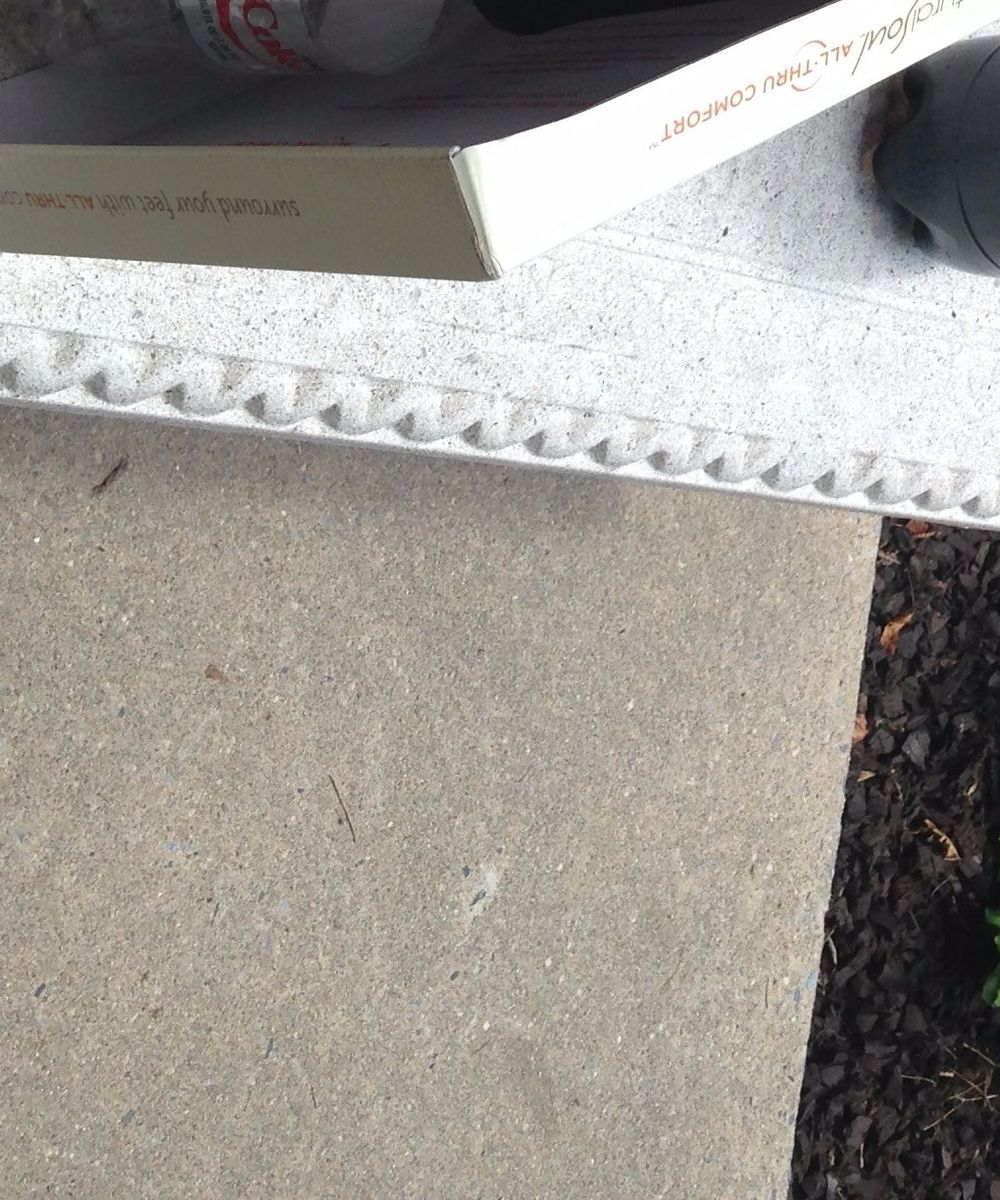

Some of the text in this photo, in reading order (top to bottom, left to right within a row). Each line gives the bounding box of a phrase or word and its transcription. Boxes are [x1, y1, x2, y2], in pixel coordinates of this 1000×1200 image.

[95, 192, 136, 218] with
[138, 191, 174, 221] feet
[175, 191, 216, 214] your
[217, 197, 301, 222] surround
